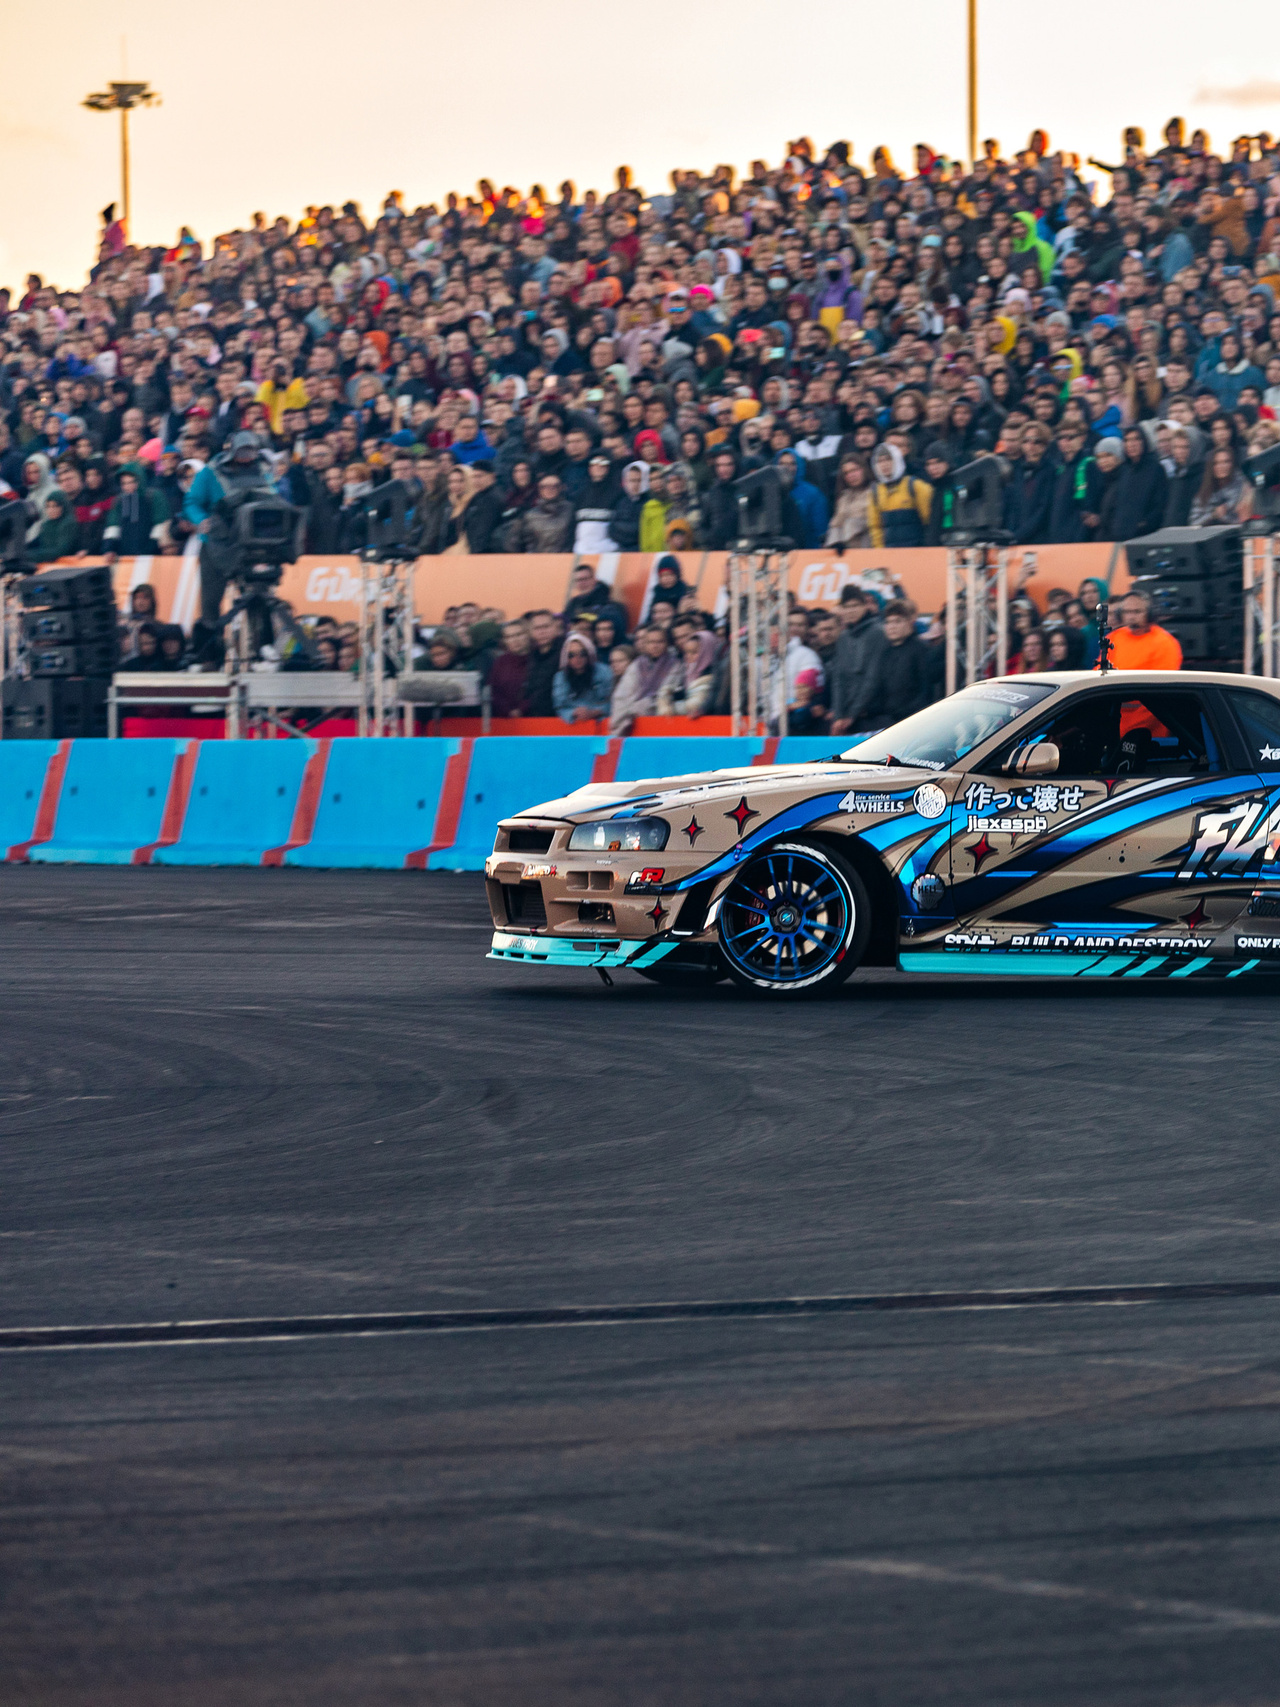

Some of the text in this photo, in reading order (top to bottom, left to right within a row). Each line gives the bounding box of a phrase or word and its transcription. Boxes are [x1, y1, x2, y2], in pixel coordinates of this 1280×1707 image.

[838, 790, 856, 813] 4
[855, 801, 905, 813] WHEELS
[1237, 937, 1272, 949] ONLY
